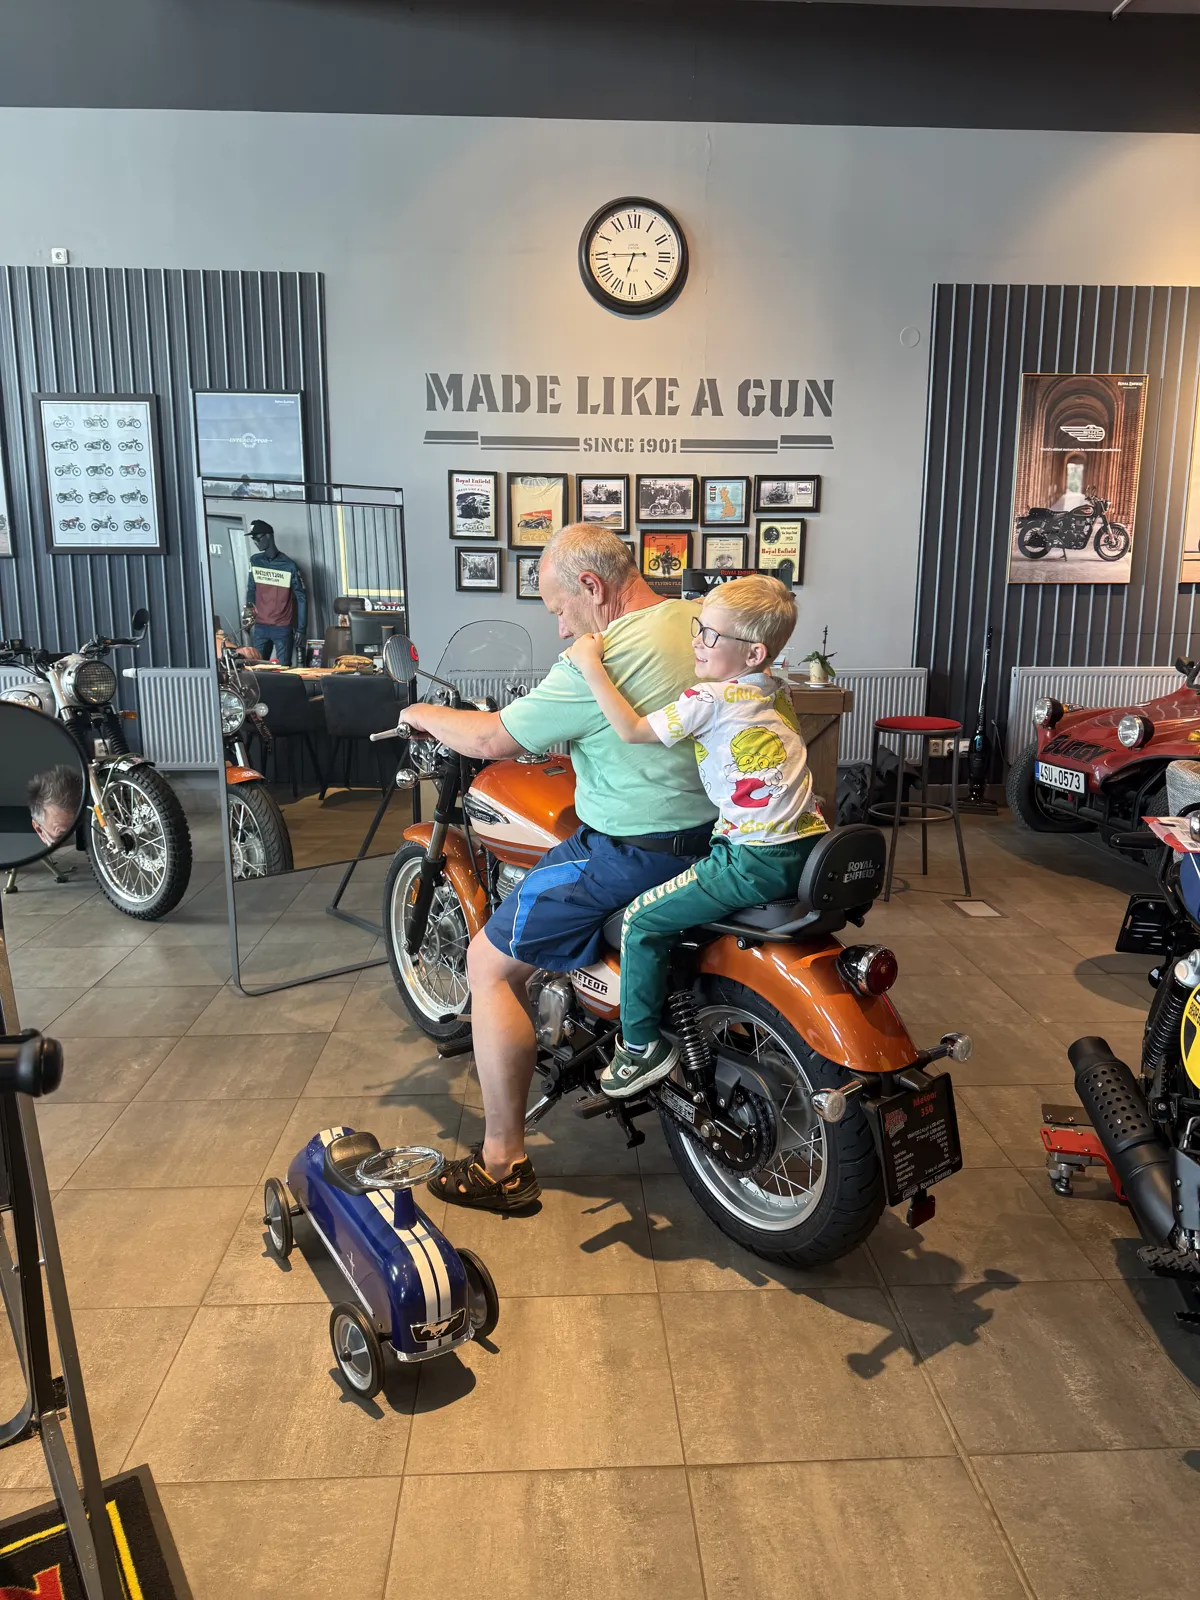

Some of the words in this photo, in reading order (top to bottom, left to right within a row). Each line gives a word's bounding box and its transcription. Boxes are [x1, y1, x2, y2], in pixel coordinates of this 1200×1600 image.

[425, 372, 562, 414] MADE
[577, 375, 680, 416] LIKE
[691, 378, 724, 417] A
[737, 378, 834, 418] GUN
[583, 437, 635, 453] SINCE
[639, 438, 677, 454] 1901
[1040, 735, 1116, 764] BUGGY
[847, 860, 873, 872] ROYAL
[842, 869, 876, 884] ENFIELD
[571, 969, 608, 993] METEOR
[913, 1091, 937, 1108] Meteor
[920, 1104, 934, 1118] 350
